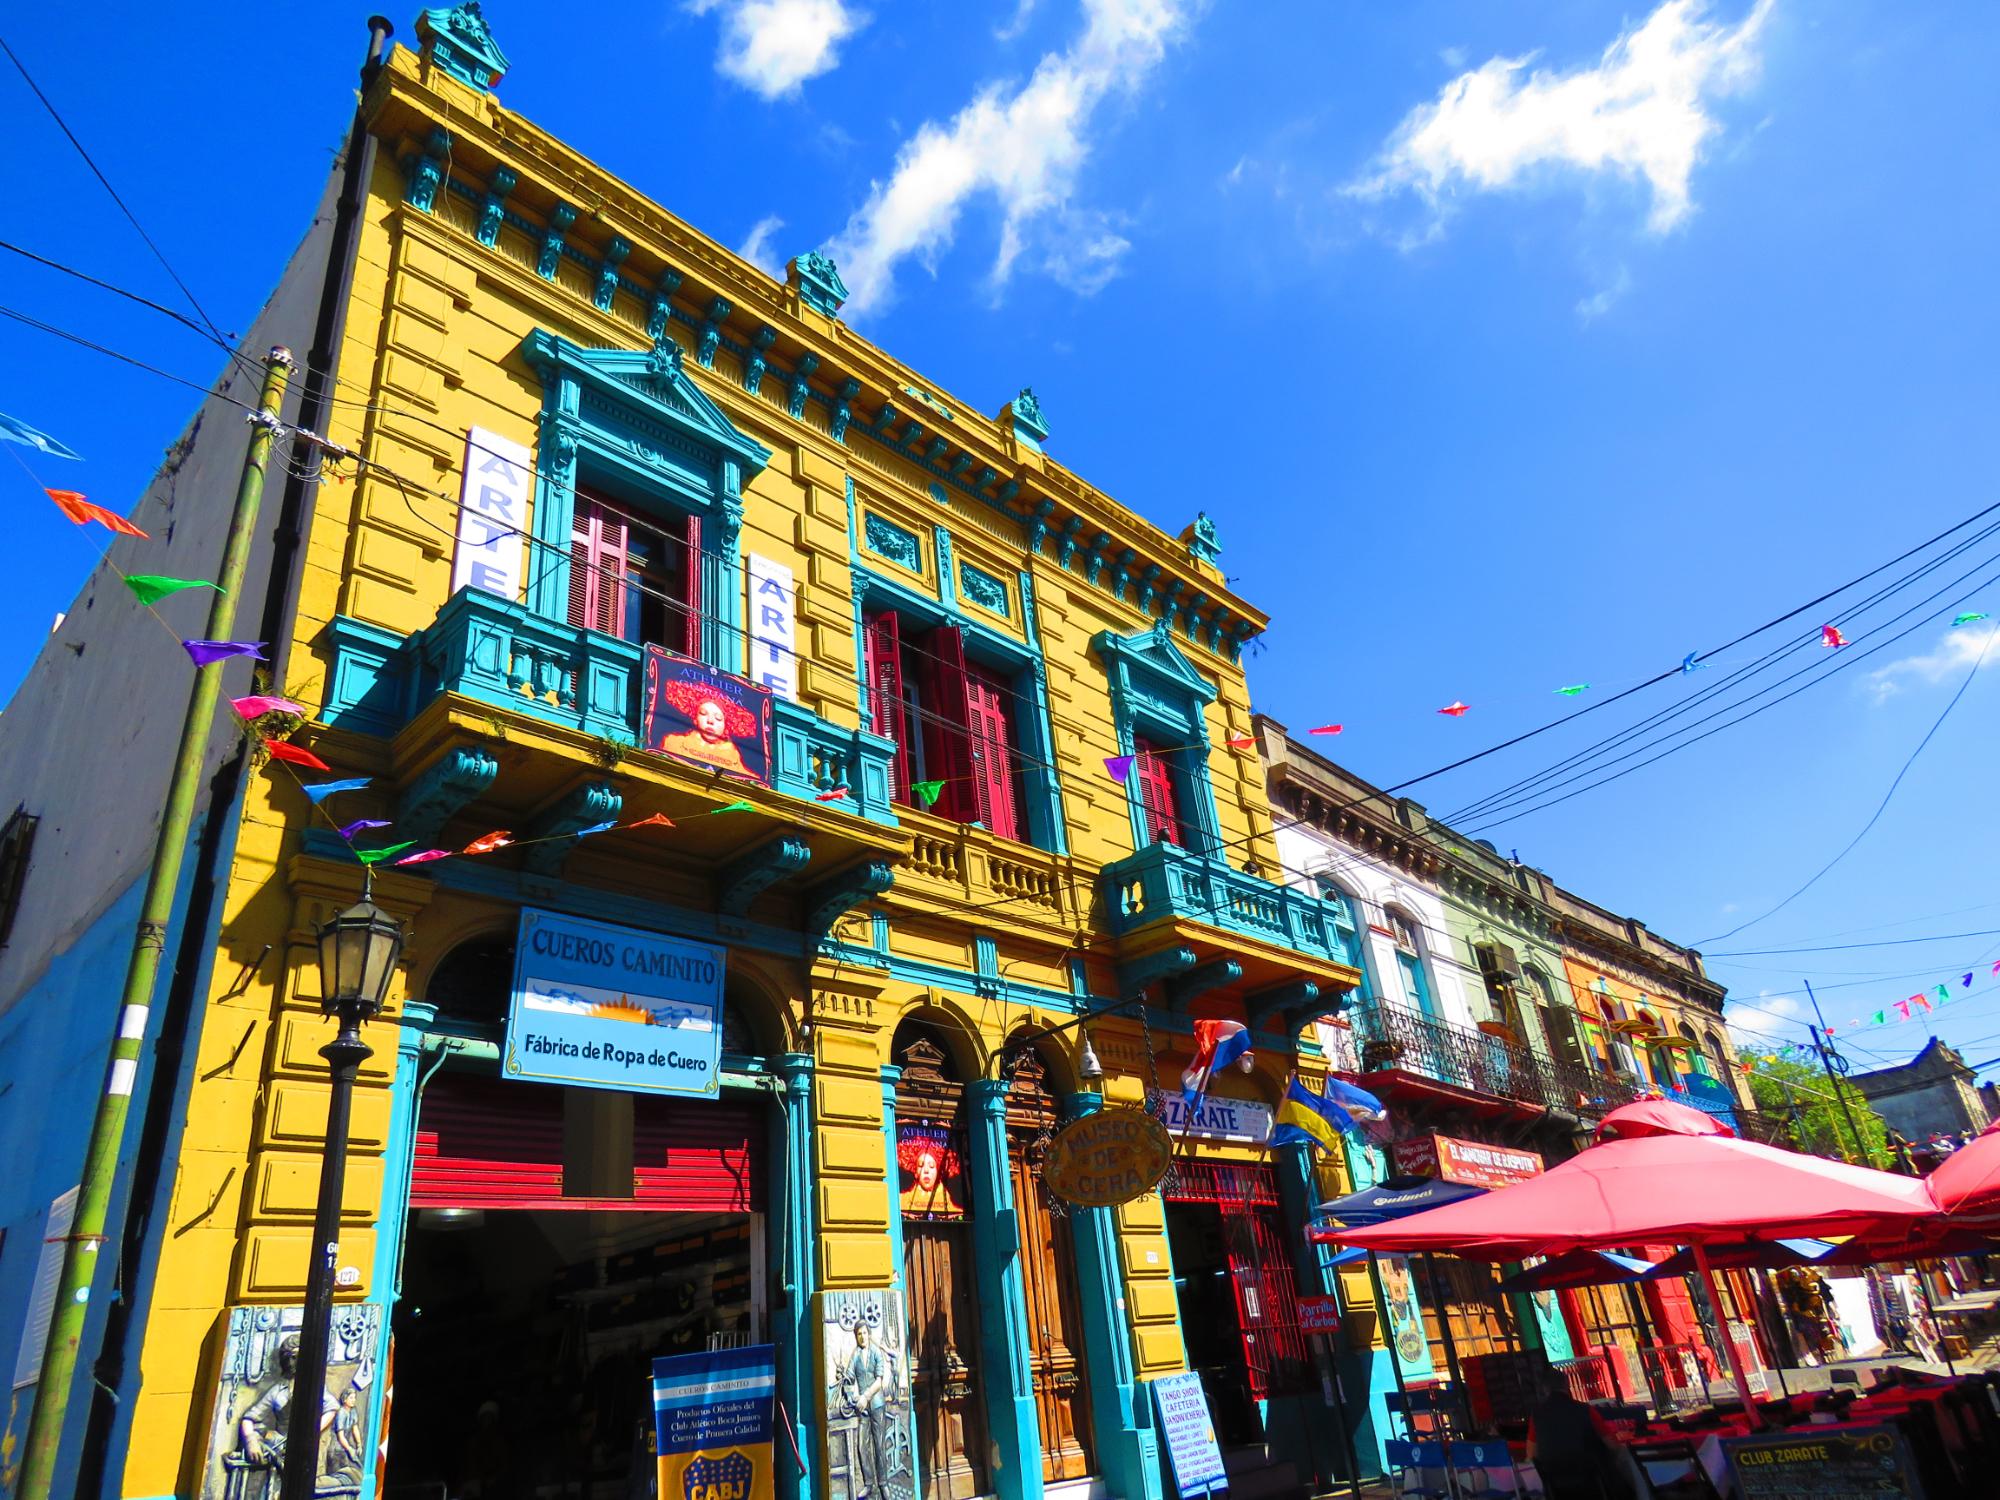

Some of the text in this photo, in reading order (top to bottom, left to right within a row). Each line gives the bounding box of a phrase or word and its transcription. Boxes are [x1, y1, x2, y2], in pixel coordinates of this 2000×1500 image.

[470, 456, 518, 598] ARTE
[758, 577, 790, 701] ARTE
[680, 667, 743, 696] ATELIER
[532, 928, 716, 984] CUEROS CAMINITO
[525, 1033, 708, 1071] Fábrica de Ropa de Cuero
[902, 1126, 948, 1139] ATELIER
[1067, 1119, 1139, 1155] MUSEO
[1093, 1147, 1118, 1171] DE
[1077, 1168, 1144, 1197] CERA
[1373, 1189, 1433, 1206] Quilmes
[711, 1380, 749, 1392] CAMINITO
[1161, 1386, 1200, 1402] TANGO SHOW
[676, 1400, 755, 1419] Productos Oficiales del
[670, 1414, 761, 1431] Club Atlético Boca Juniors
[671, 1424, 761, 1443] Cuero de Primera Calidad
[1740, 1446, 1829, 1465] CLUB ZARATE
[691, 1480, 744, 1500] CABJ
